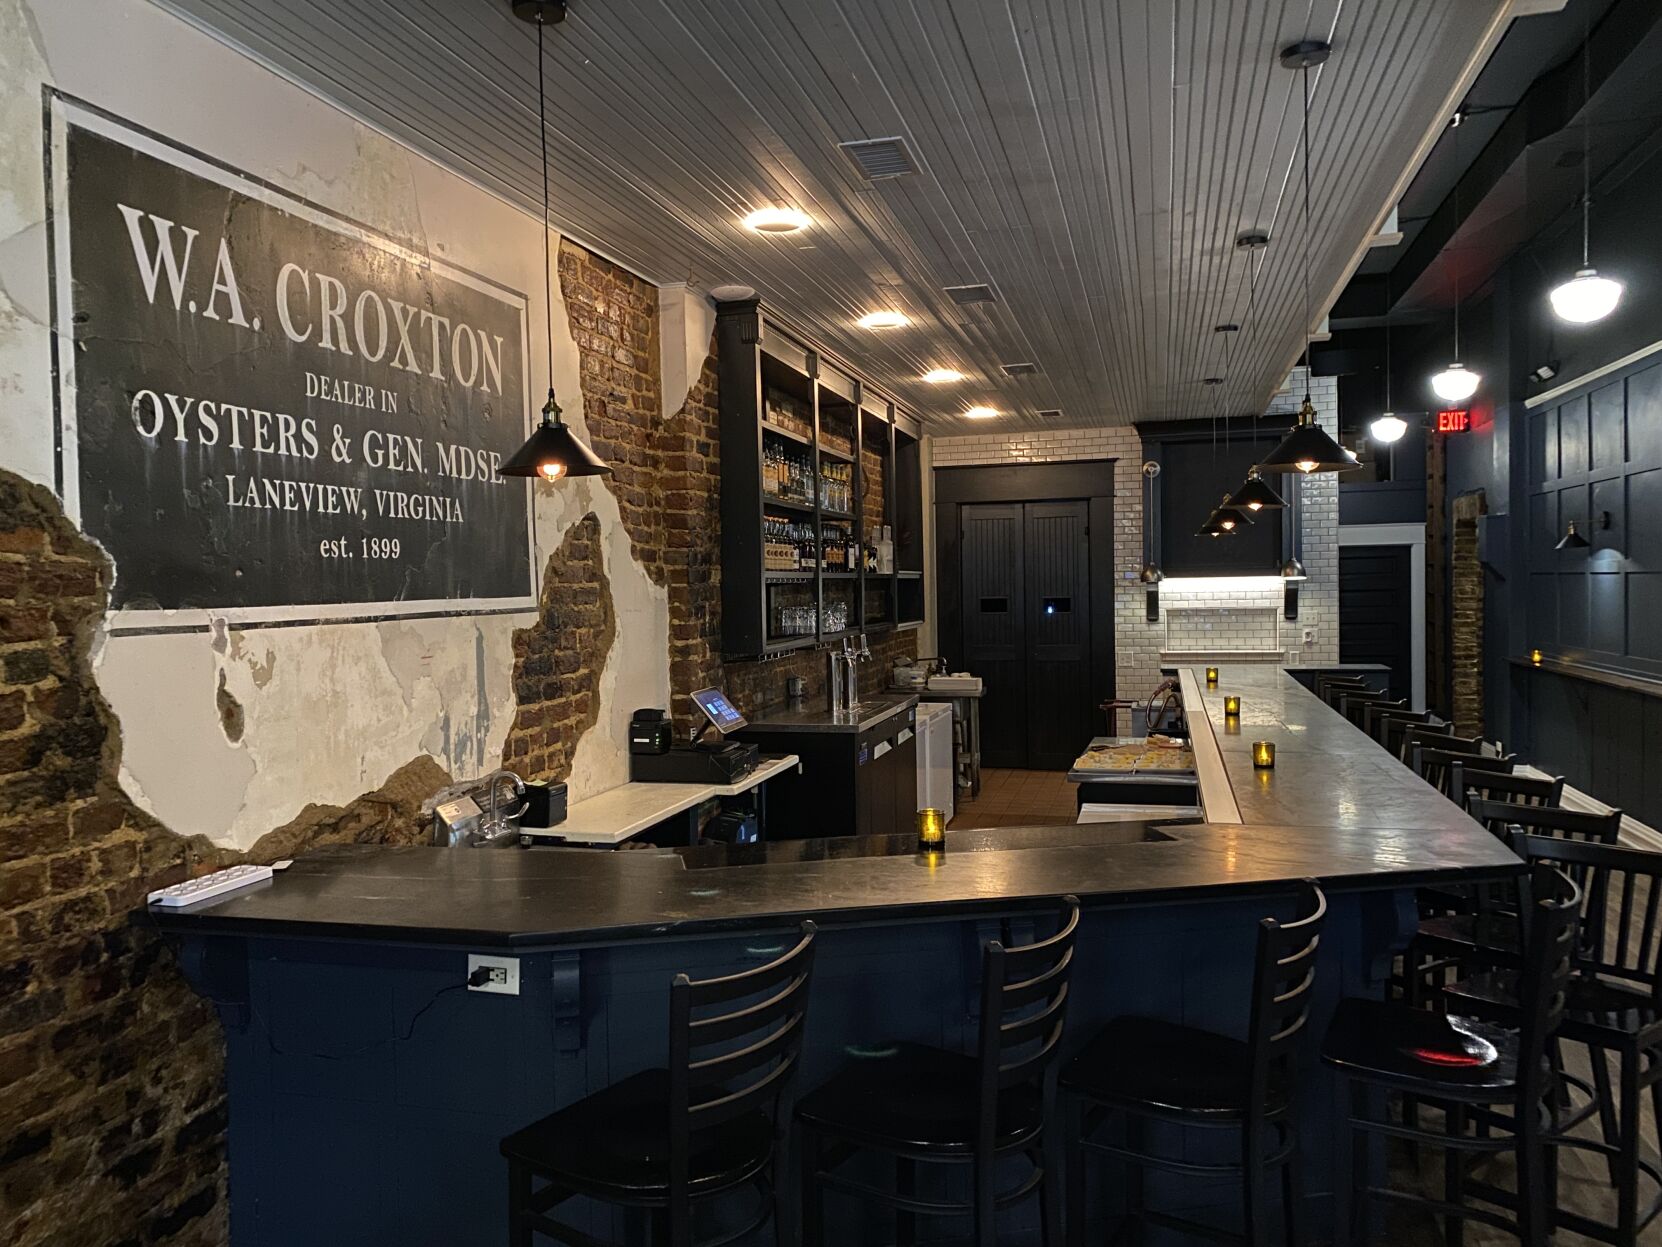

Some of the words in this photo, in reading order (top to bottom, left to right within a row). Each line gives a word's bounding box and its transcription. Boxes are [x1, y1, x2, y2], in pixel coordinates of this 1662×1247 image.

[117, 203, 262, 332] W.A.
[275, 262, 504, 396] CROXTON
[304, 371, 376, 409] DEALER
[380, 391, 399, 413] IN
[130, 389, 319, 460] OYSTERS
[331, 423, 353, 464] &
[362, 431, 429, 475] GEN.
[436, 441, 507, 486] MDSE.
[1439, 412, 1466, 431] EXIT
[225, 474, 368, 520] LANEVIEW,
[375, 491, 464, 523] VIRGINIA
[319, 537, 354, 560] est.
[361, 538, 401, 560] 1899
